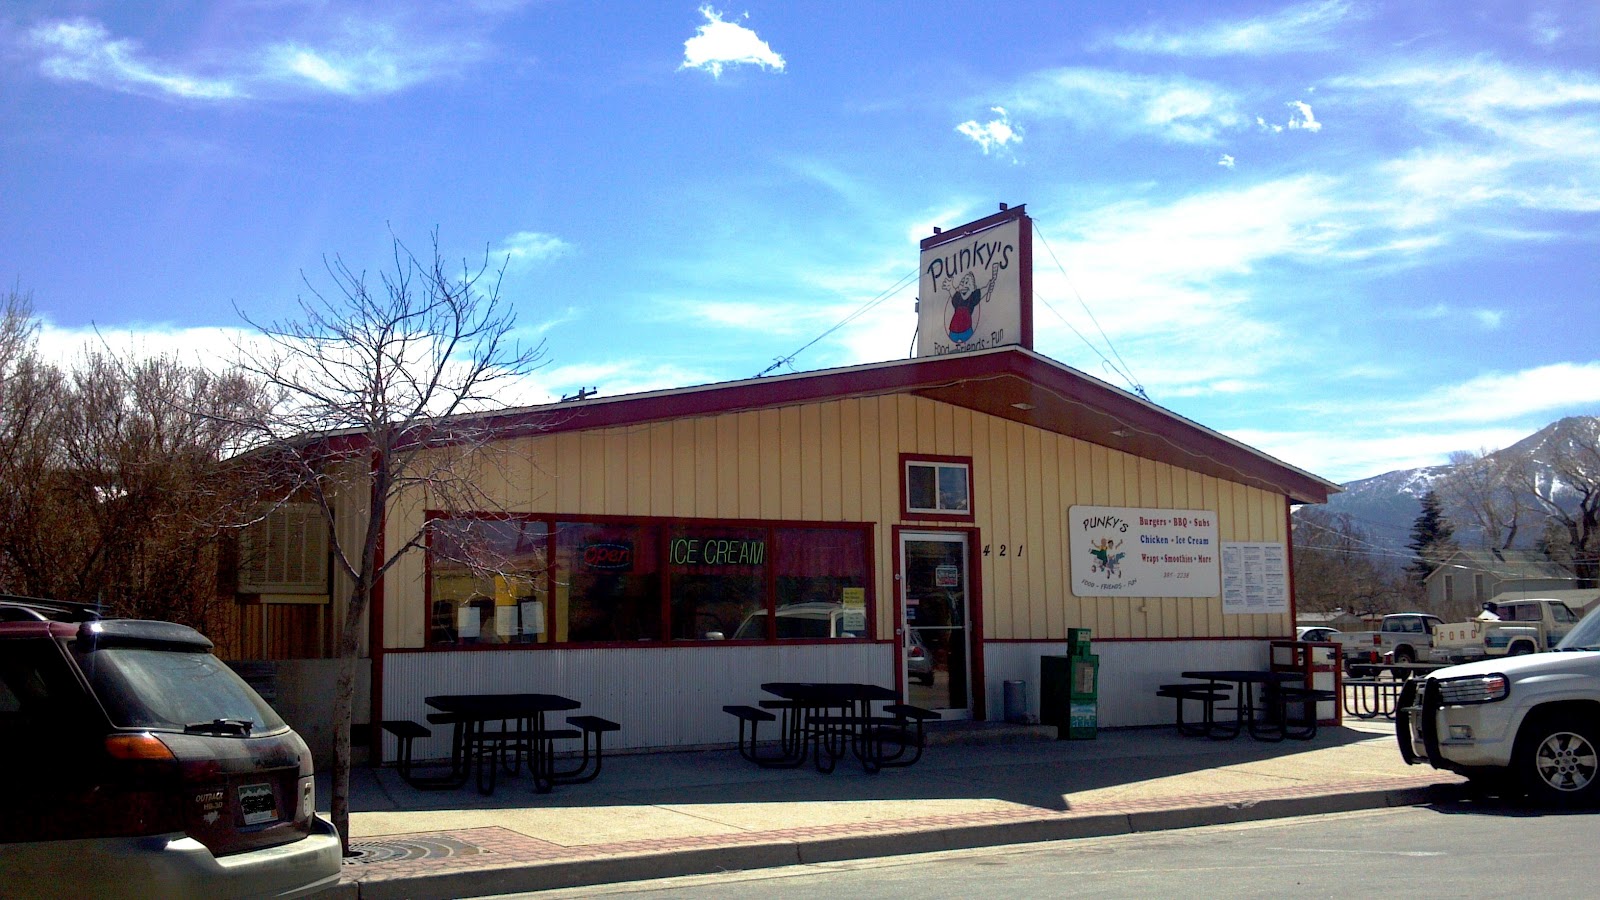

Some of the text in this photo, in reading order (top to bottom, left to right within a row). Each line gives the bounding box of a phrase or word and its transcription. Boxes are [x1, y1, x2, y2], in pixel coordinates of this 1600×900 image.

[991, 328, 1004, 348] Fun
[1083, 515, 1129, 533] PUNKY'S
[1139, 516, 1210, 528] Burgers BBQ Subs
[1140, 534, 1209, 545] Chicken Ice Cream
[669, 539, 764, 565] ICE CREAM
[983, 544, 1023, 557] 421
[1141, 553, 1212, 564] Wraps Smoothies More
[1101, 582, 1122, 590] FRIENDS
[1440, 630, 1477, 640] FORD
